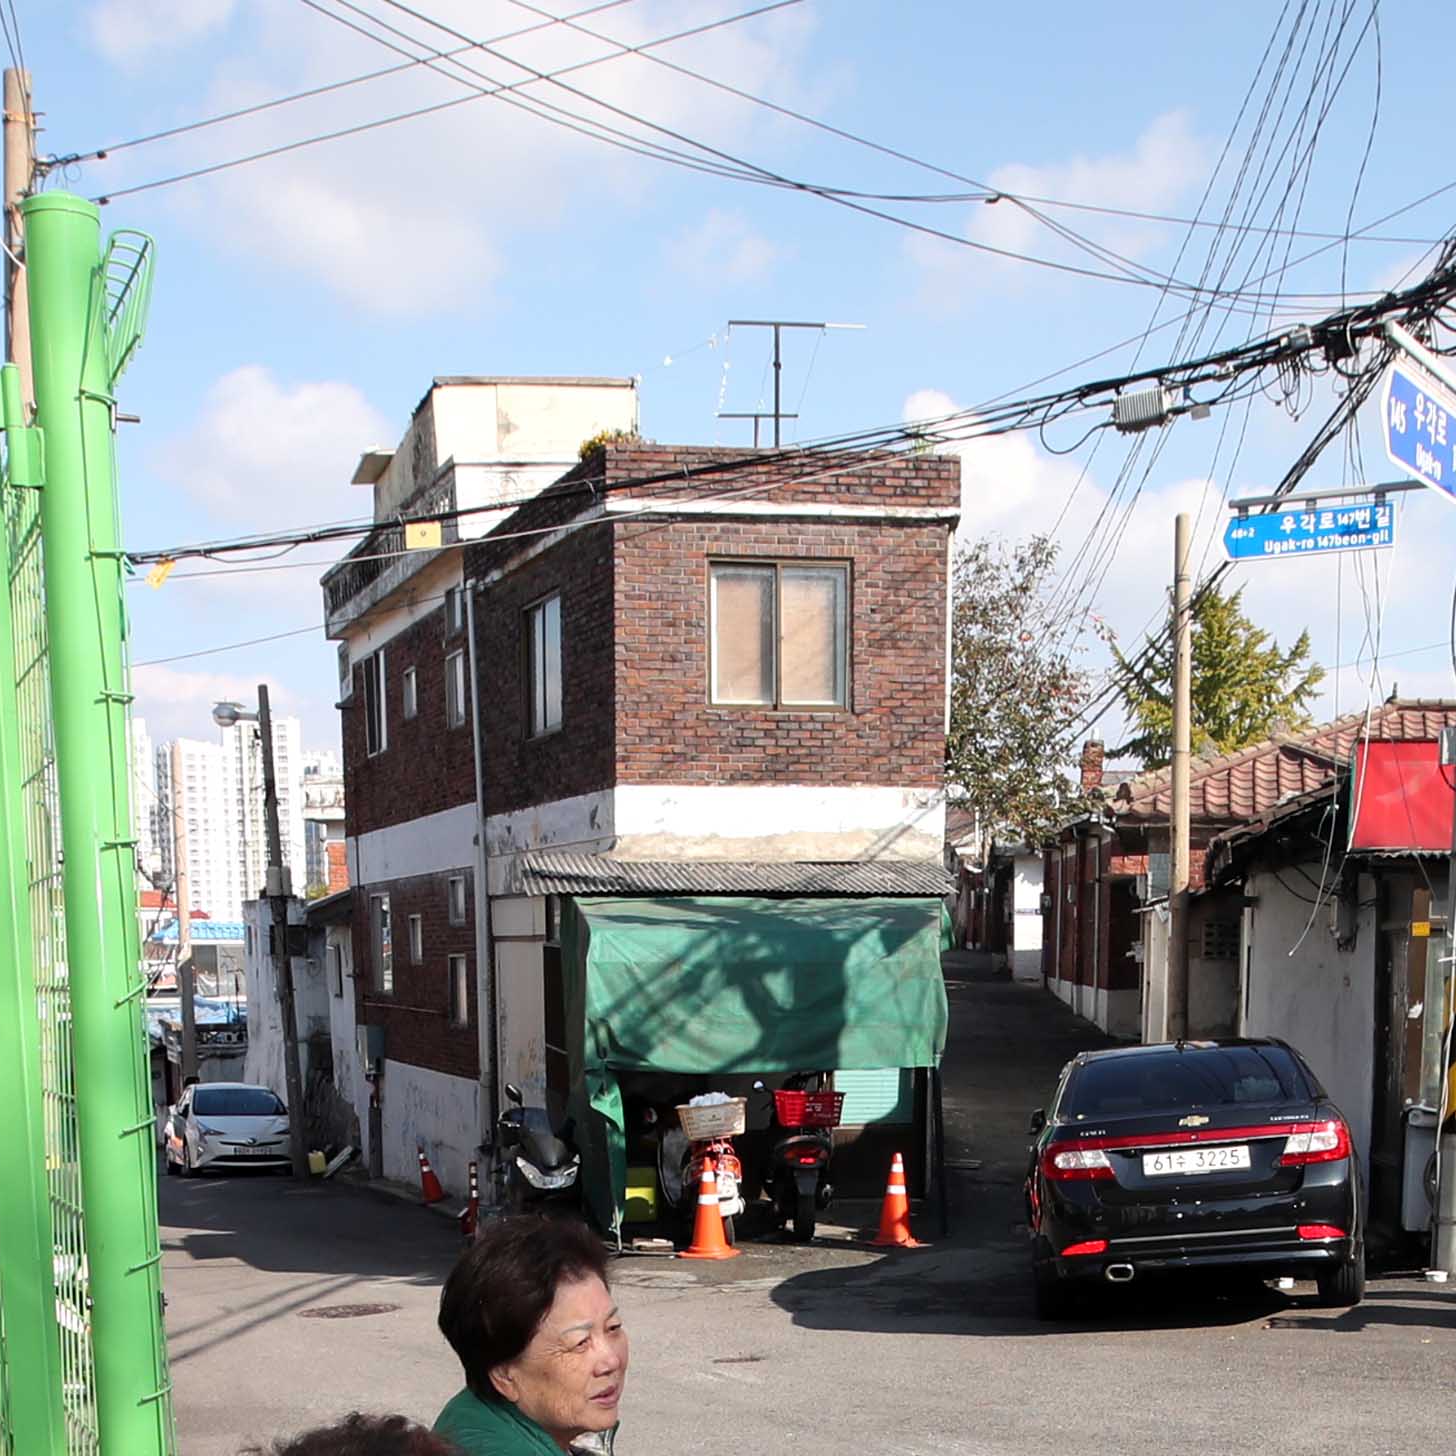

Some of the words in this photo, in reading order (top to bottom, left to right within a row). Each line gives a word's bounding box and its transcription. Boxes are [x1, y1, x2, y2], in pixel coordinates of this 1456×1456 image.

[1390, 396, 1407, 434] 145
[1413, 392, 1448, 446] 우각로
[1152, 1154, 1186, 1172] 61수
[1195, 1149, 1241, 1168] 3225
